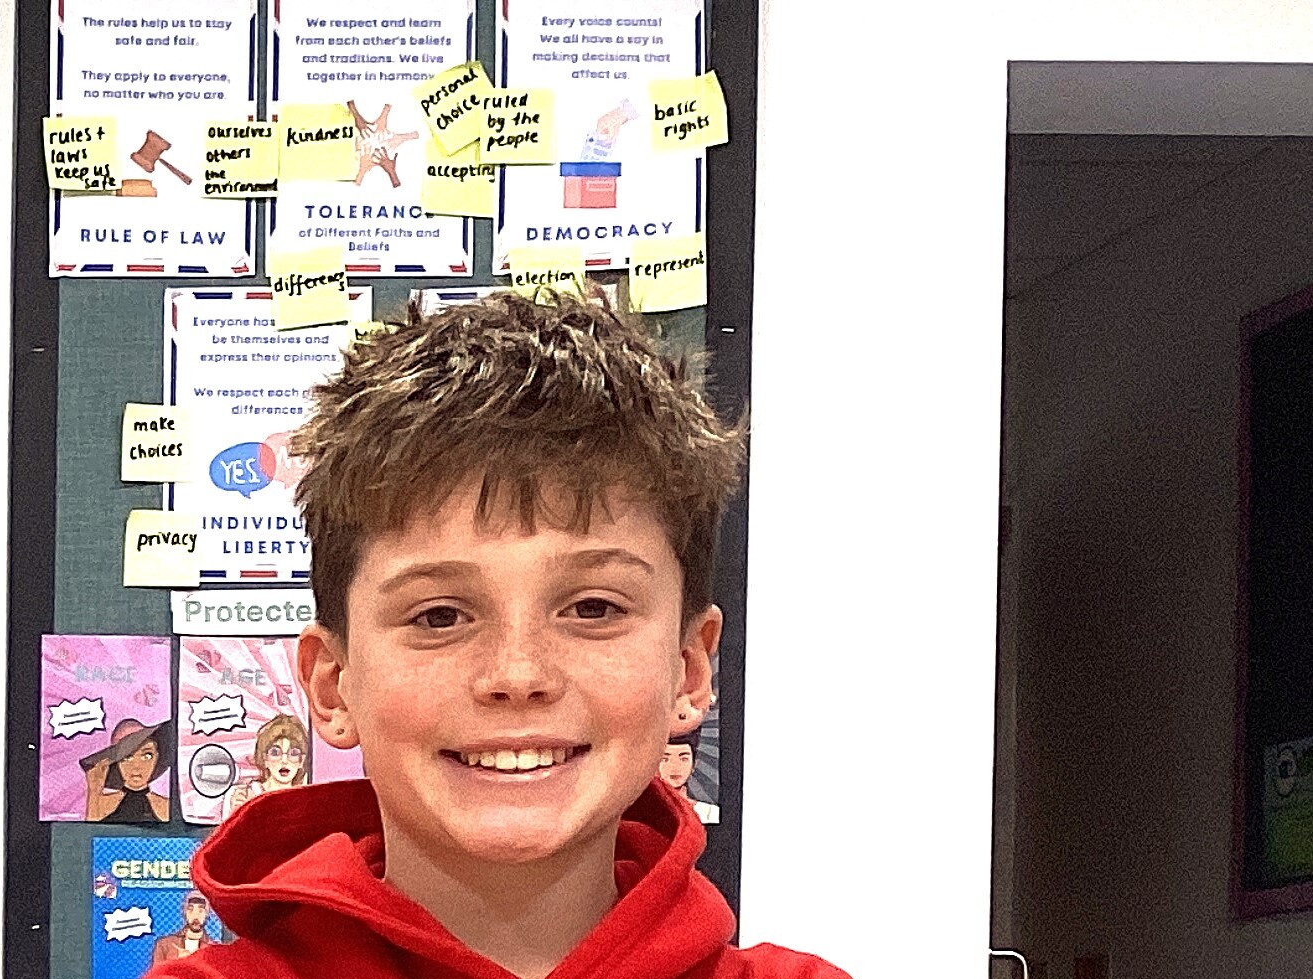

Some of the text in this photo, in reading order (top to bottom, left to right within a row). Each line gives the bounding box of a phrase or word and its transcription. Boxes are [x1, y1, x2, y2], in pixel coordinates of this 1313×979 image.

[82, 17, 232, 30] The rules help us to stay
[306, 18, 326, 27] We
[330, 18, 378, 29] respect
[381, 17, 406, 27] and
[541, 16, 663, 28] Every voice counts!
[115, 35, 142, 46] safe
[145, 35, 170, 46] and
[295, 35, 451, 46] from each other's beliefs
[540, 34, 560, 43] We
[562, 34, 579, 43] all
[581, 34, 613, 43] have
[627, 36, 650, 46] say
[652, 36, 664, 44] in
[302, 53, 444, 63] and traditions. We live
[532, 52, 671, 63] making decisions that
[81, 70, 230, 84] They apply to everyone,
[306, 71, 362, 83] together
[365, 71, 376, 81] in
[571, 69, 610, 79] affect
[83, 89, 99, 98] no
[102, 89, 145, 98] matter
[148, 90, 174, 99] who
[178, 90, 200, 101] you
[421, 68, 478, 117] personal
[483, 93, 528, 110] ruled
[654, 100, 697, 120] basic
[487, 112, 539, 132] by the
[664, 115, 709, 140] rights
[49, 127, 92, 144] rules
[207, 126, 272, 138] ourselves
[486, 131, 539, 151] people
[51, 148, 87, 163] laws
[206, 148, 251, 163] others
[94, 163, 110, 178] us
[205, 169, 226, 180] the
[427, 165, 495, 183] accepting
[84, 171, 116, 189] safe
[304, 205, 434, 219] TOLERANC
[80, 228, 226, 245] RULE OF LAW
[298, 228, 440, 238] of Different Faiths and
[526, 221, 673, 241] DEMOCRACY
[348, 241, 390, 251] Beliefs
[635, 250, 705, 279] represent
[515, 269, 576, 286] election
[193, 316, 276, 328] Everyone has
[212, 334, 330, 344] be themselves and
[199, 353, 248, 363] express
[251, 353, 281, 362] their
[193, 387, 213, 397] We
[217, 387, 264, 398] respect
[267, 387, 299, 397] each
[133, 417, 175, 432] make
[220, 457, 261, 485] YES
[202, 516, 305, 530] INDIVIDU
[137, 531, 197, 552] privacy
[223, 541, 310, 554] LIBERTY
[185, 601, 312, 622] Protecte
[220, 666, 266, 685] AGE
[112, 860, 190, 879] GENDE
